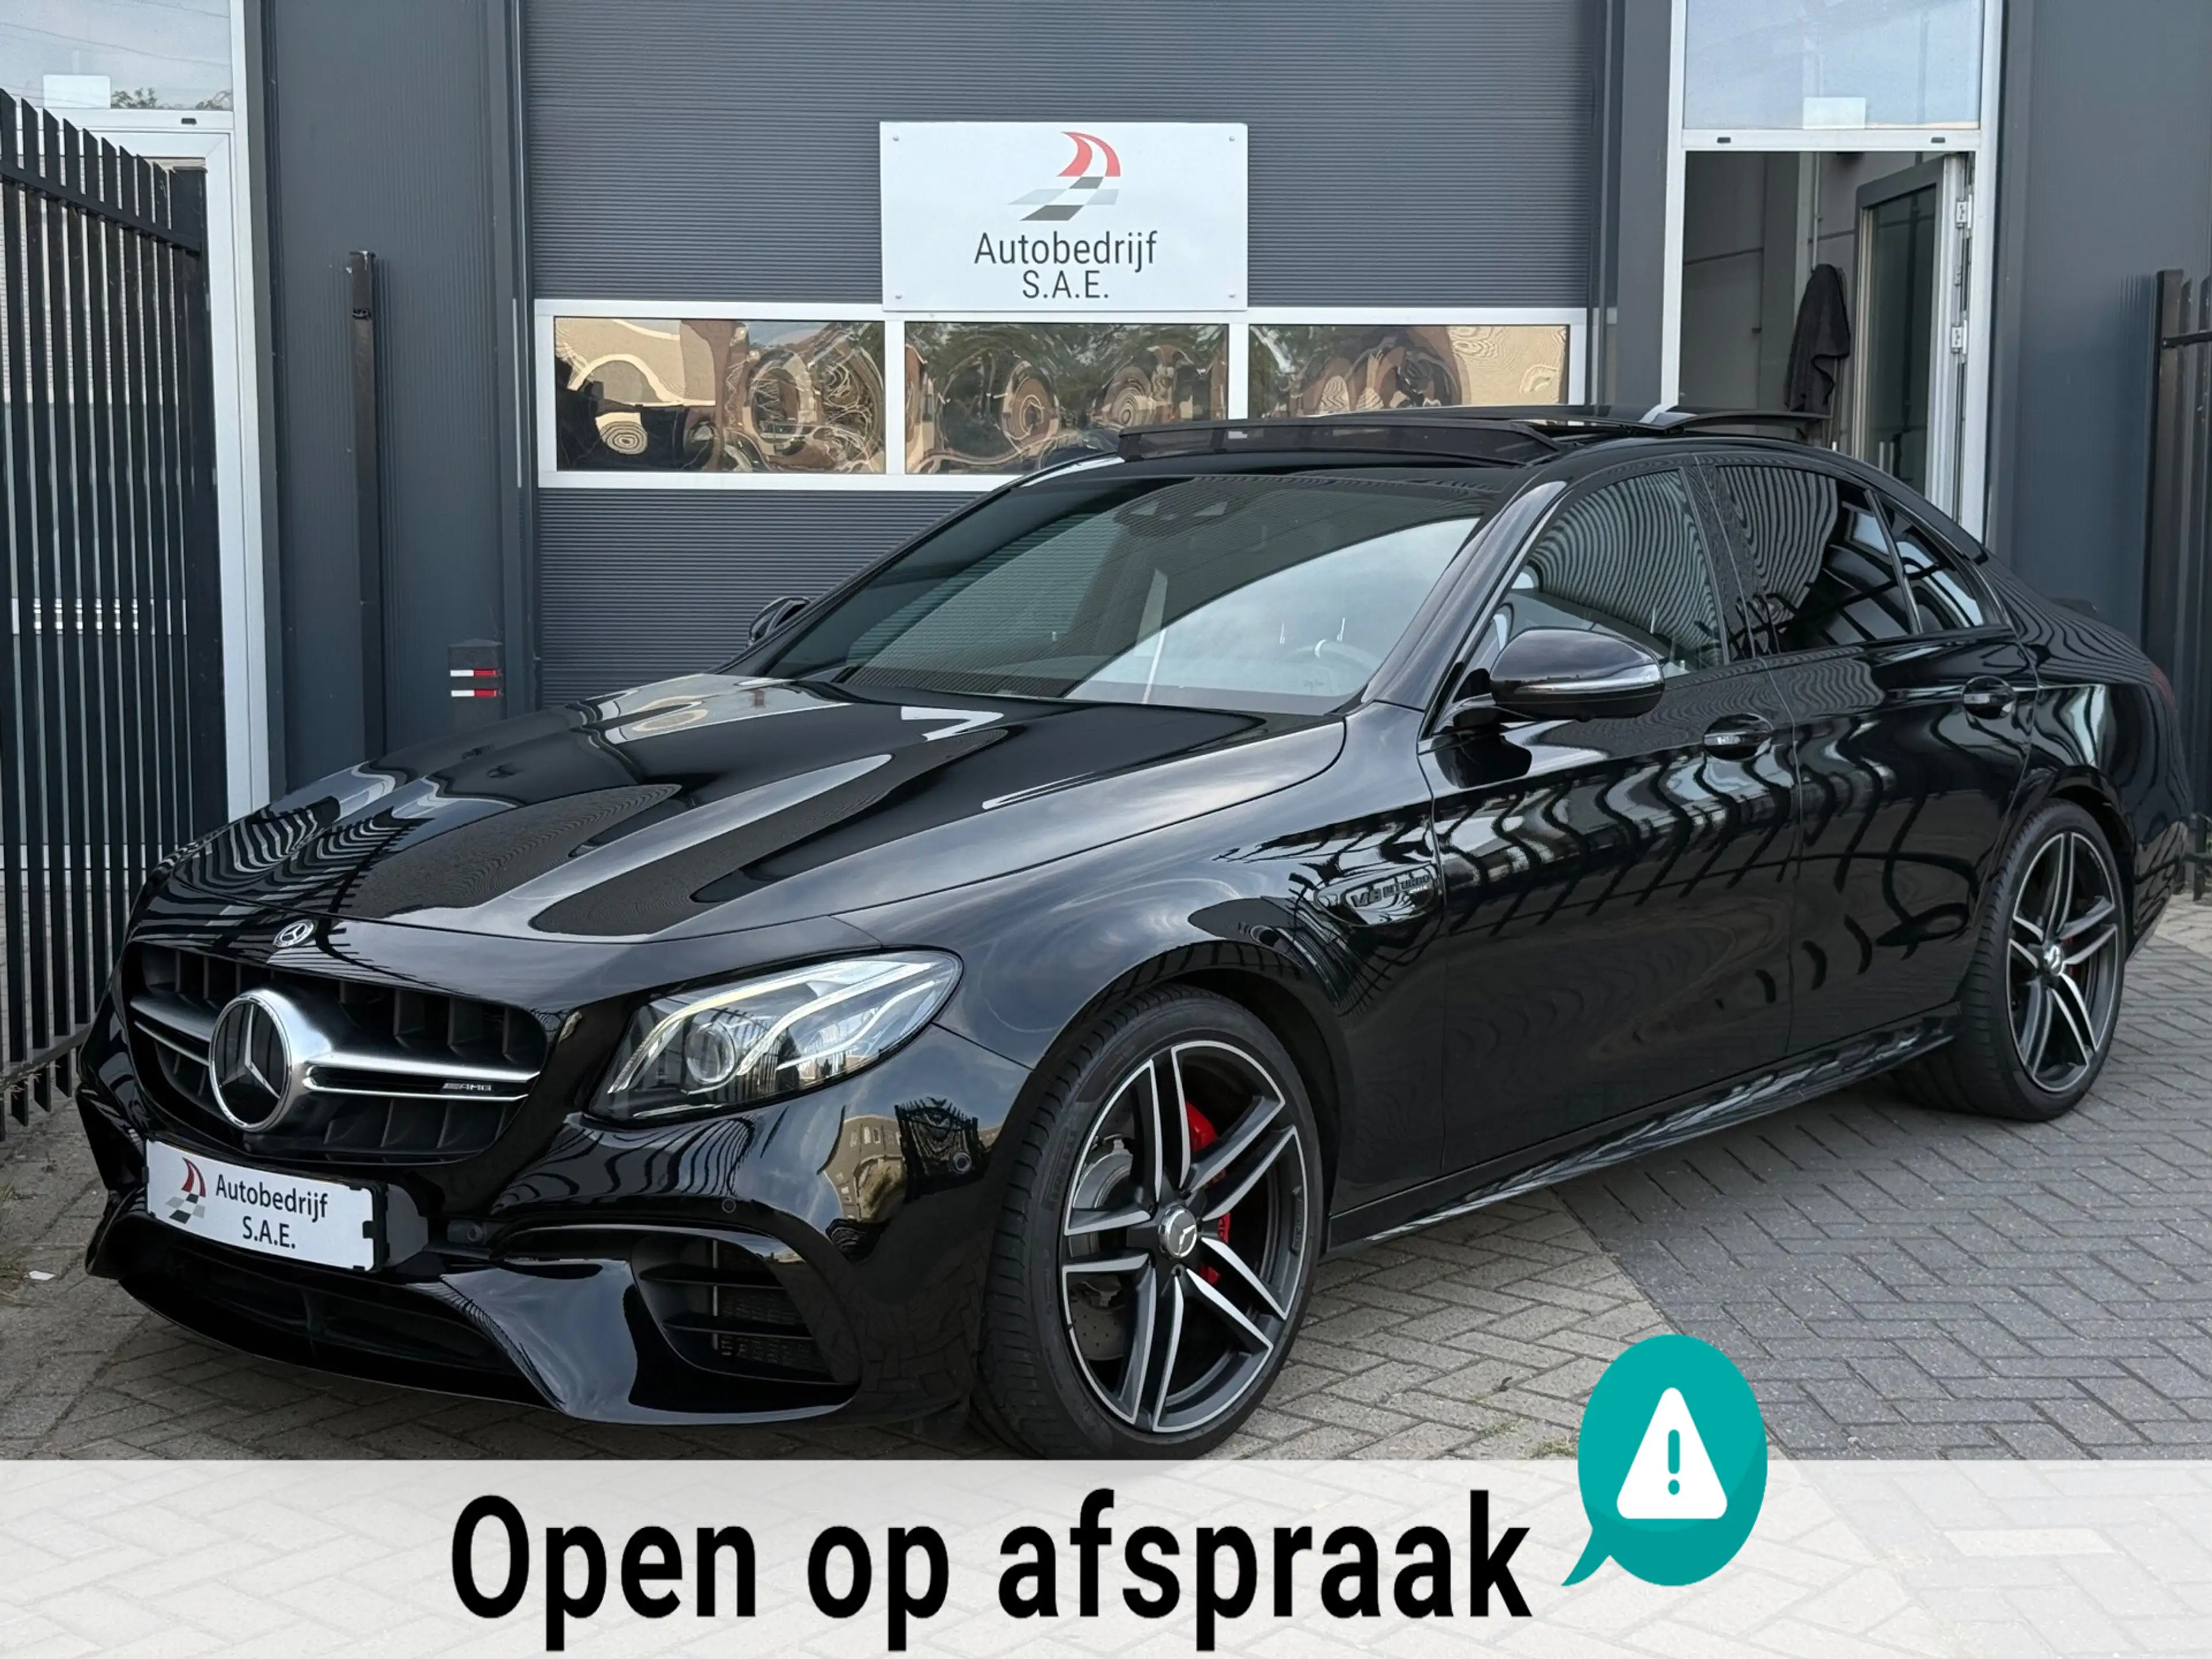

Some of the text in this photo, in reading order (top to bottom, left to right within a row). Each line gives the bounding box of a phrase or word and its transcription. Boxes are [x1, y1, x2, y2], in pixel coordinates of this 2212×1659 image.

[974, 230, 1157, 272] Autobedrijf
[1022, 270, 1109, 298] S.A.E.
[1350, 888, 1382, 908] V8
[459, 1083, 492, 1092] AMG
[215, 1173, 328, 1223] Autobedrijf
[243, 1215, 296, 1249] S.A.E.
